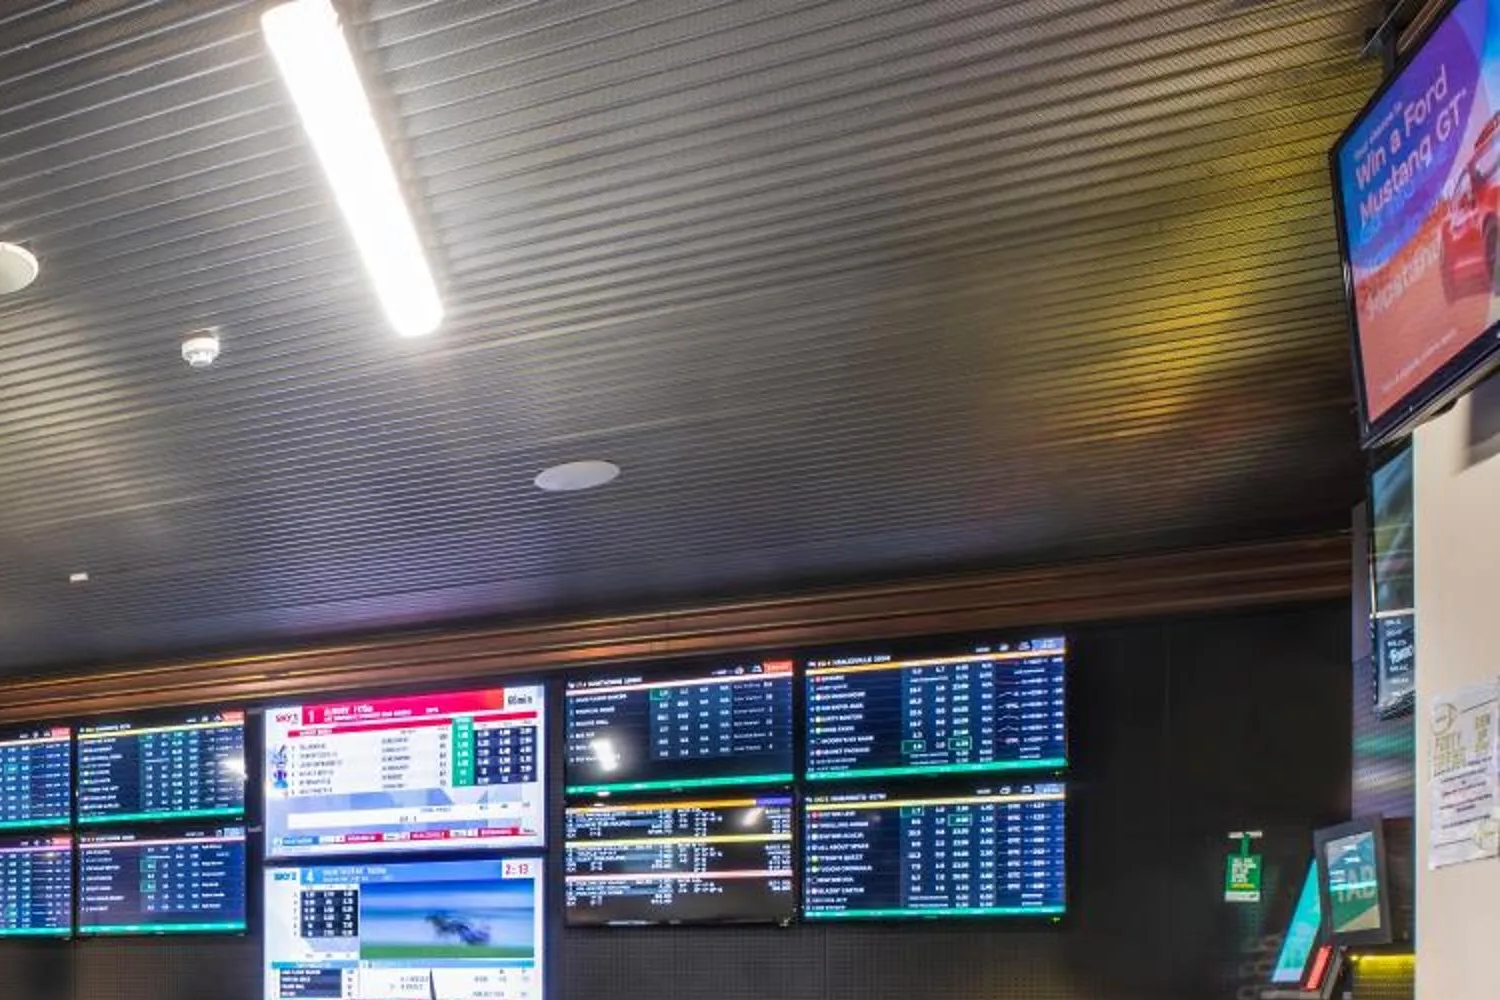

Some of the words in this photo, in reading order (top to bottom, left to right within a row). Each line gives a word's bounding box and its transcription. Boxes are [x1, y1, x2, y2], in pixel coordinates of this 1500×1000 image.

[1355, 146, 1387, 190] Win
[1390, 129, 1401, 153] a
[1404, 64, 1448, 137] Ford
[1360, 135, 1432, 223] Mustang
[308, 710, 315, 723] 1
